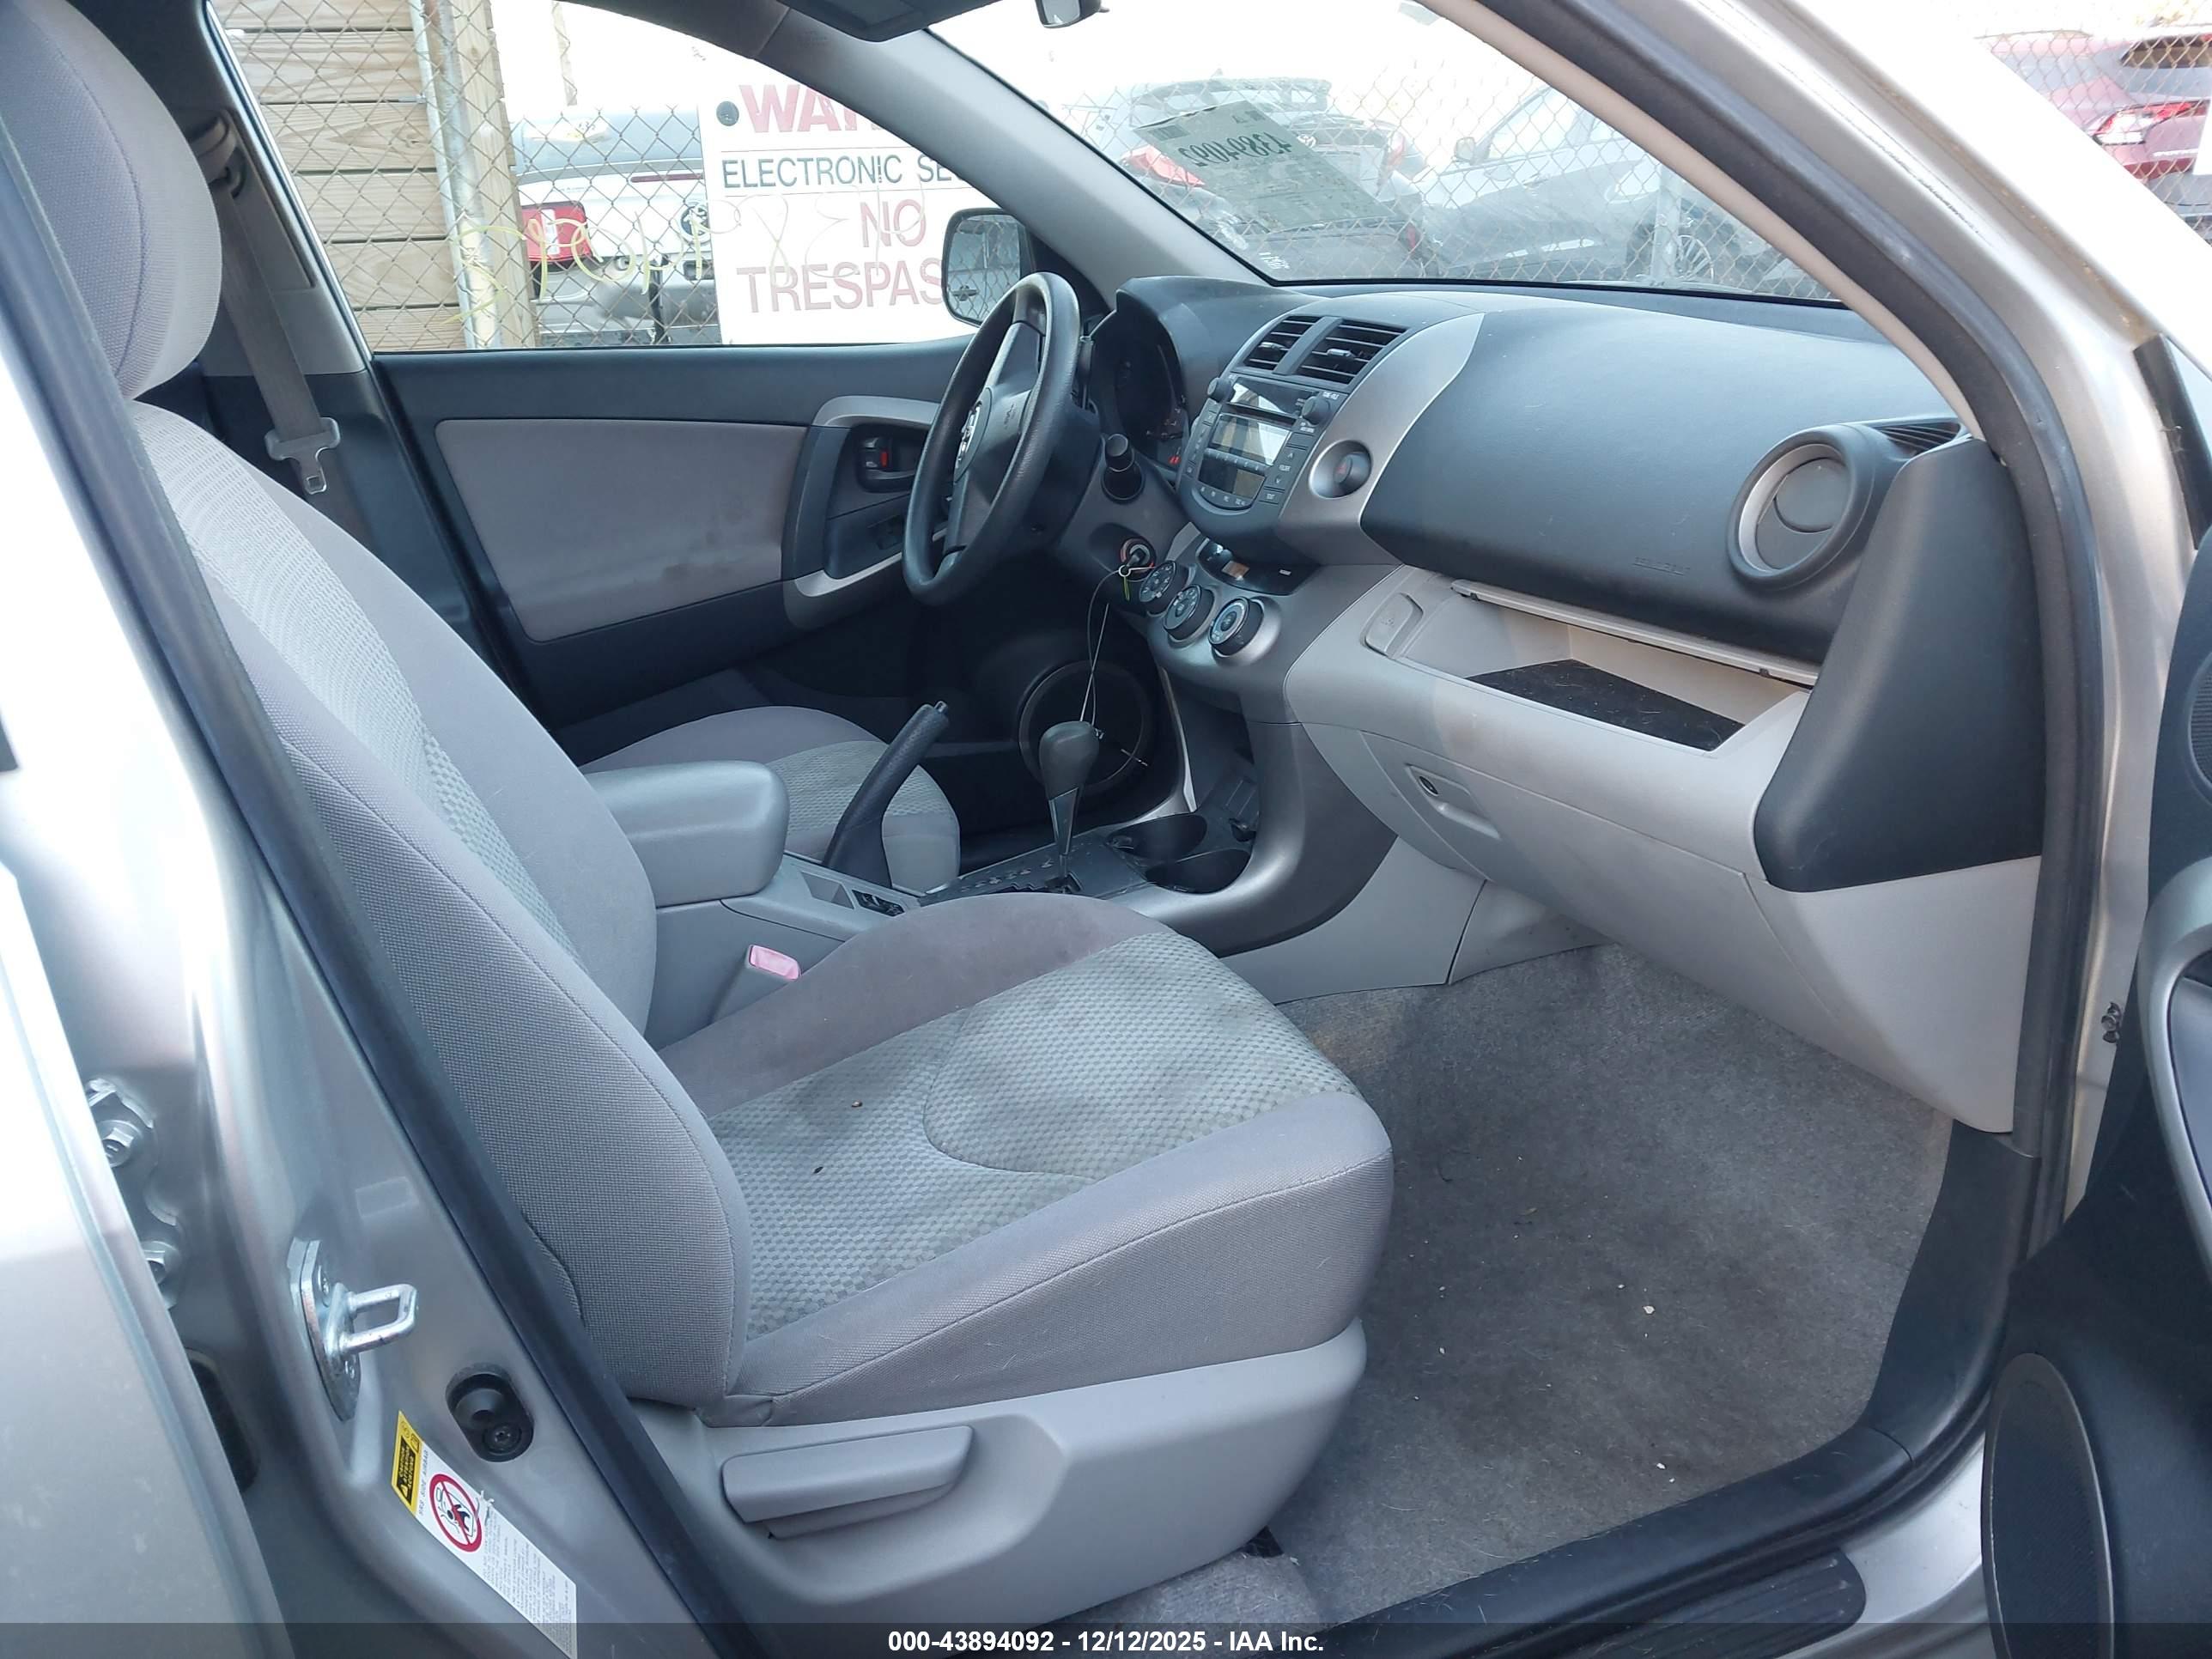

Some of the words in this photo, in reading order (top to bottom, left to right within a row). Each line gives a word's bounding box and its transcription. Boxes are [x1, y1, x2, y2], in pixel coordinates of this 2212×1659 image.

[738, 84, 882, 132] WA
[722, 155, 902, 188] ELECTRONIC
[917, 154, 963, 182] SE
[860, 199, 926, 247] NO
[736, 258, 943, 313] TRESPAS
